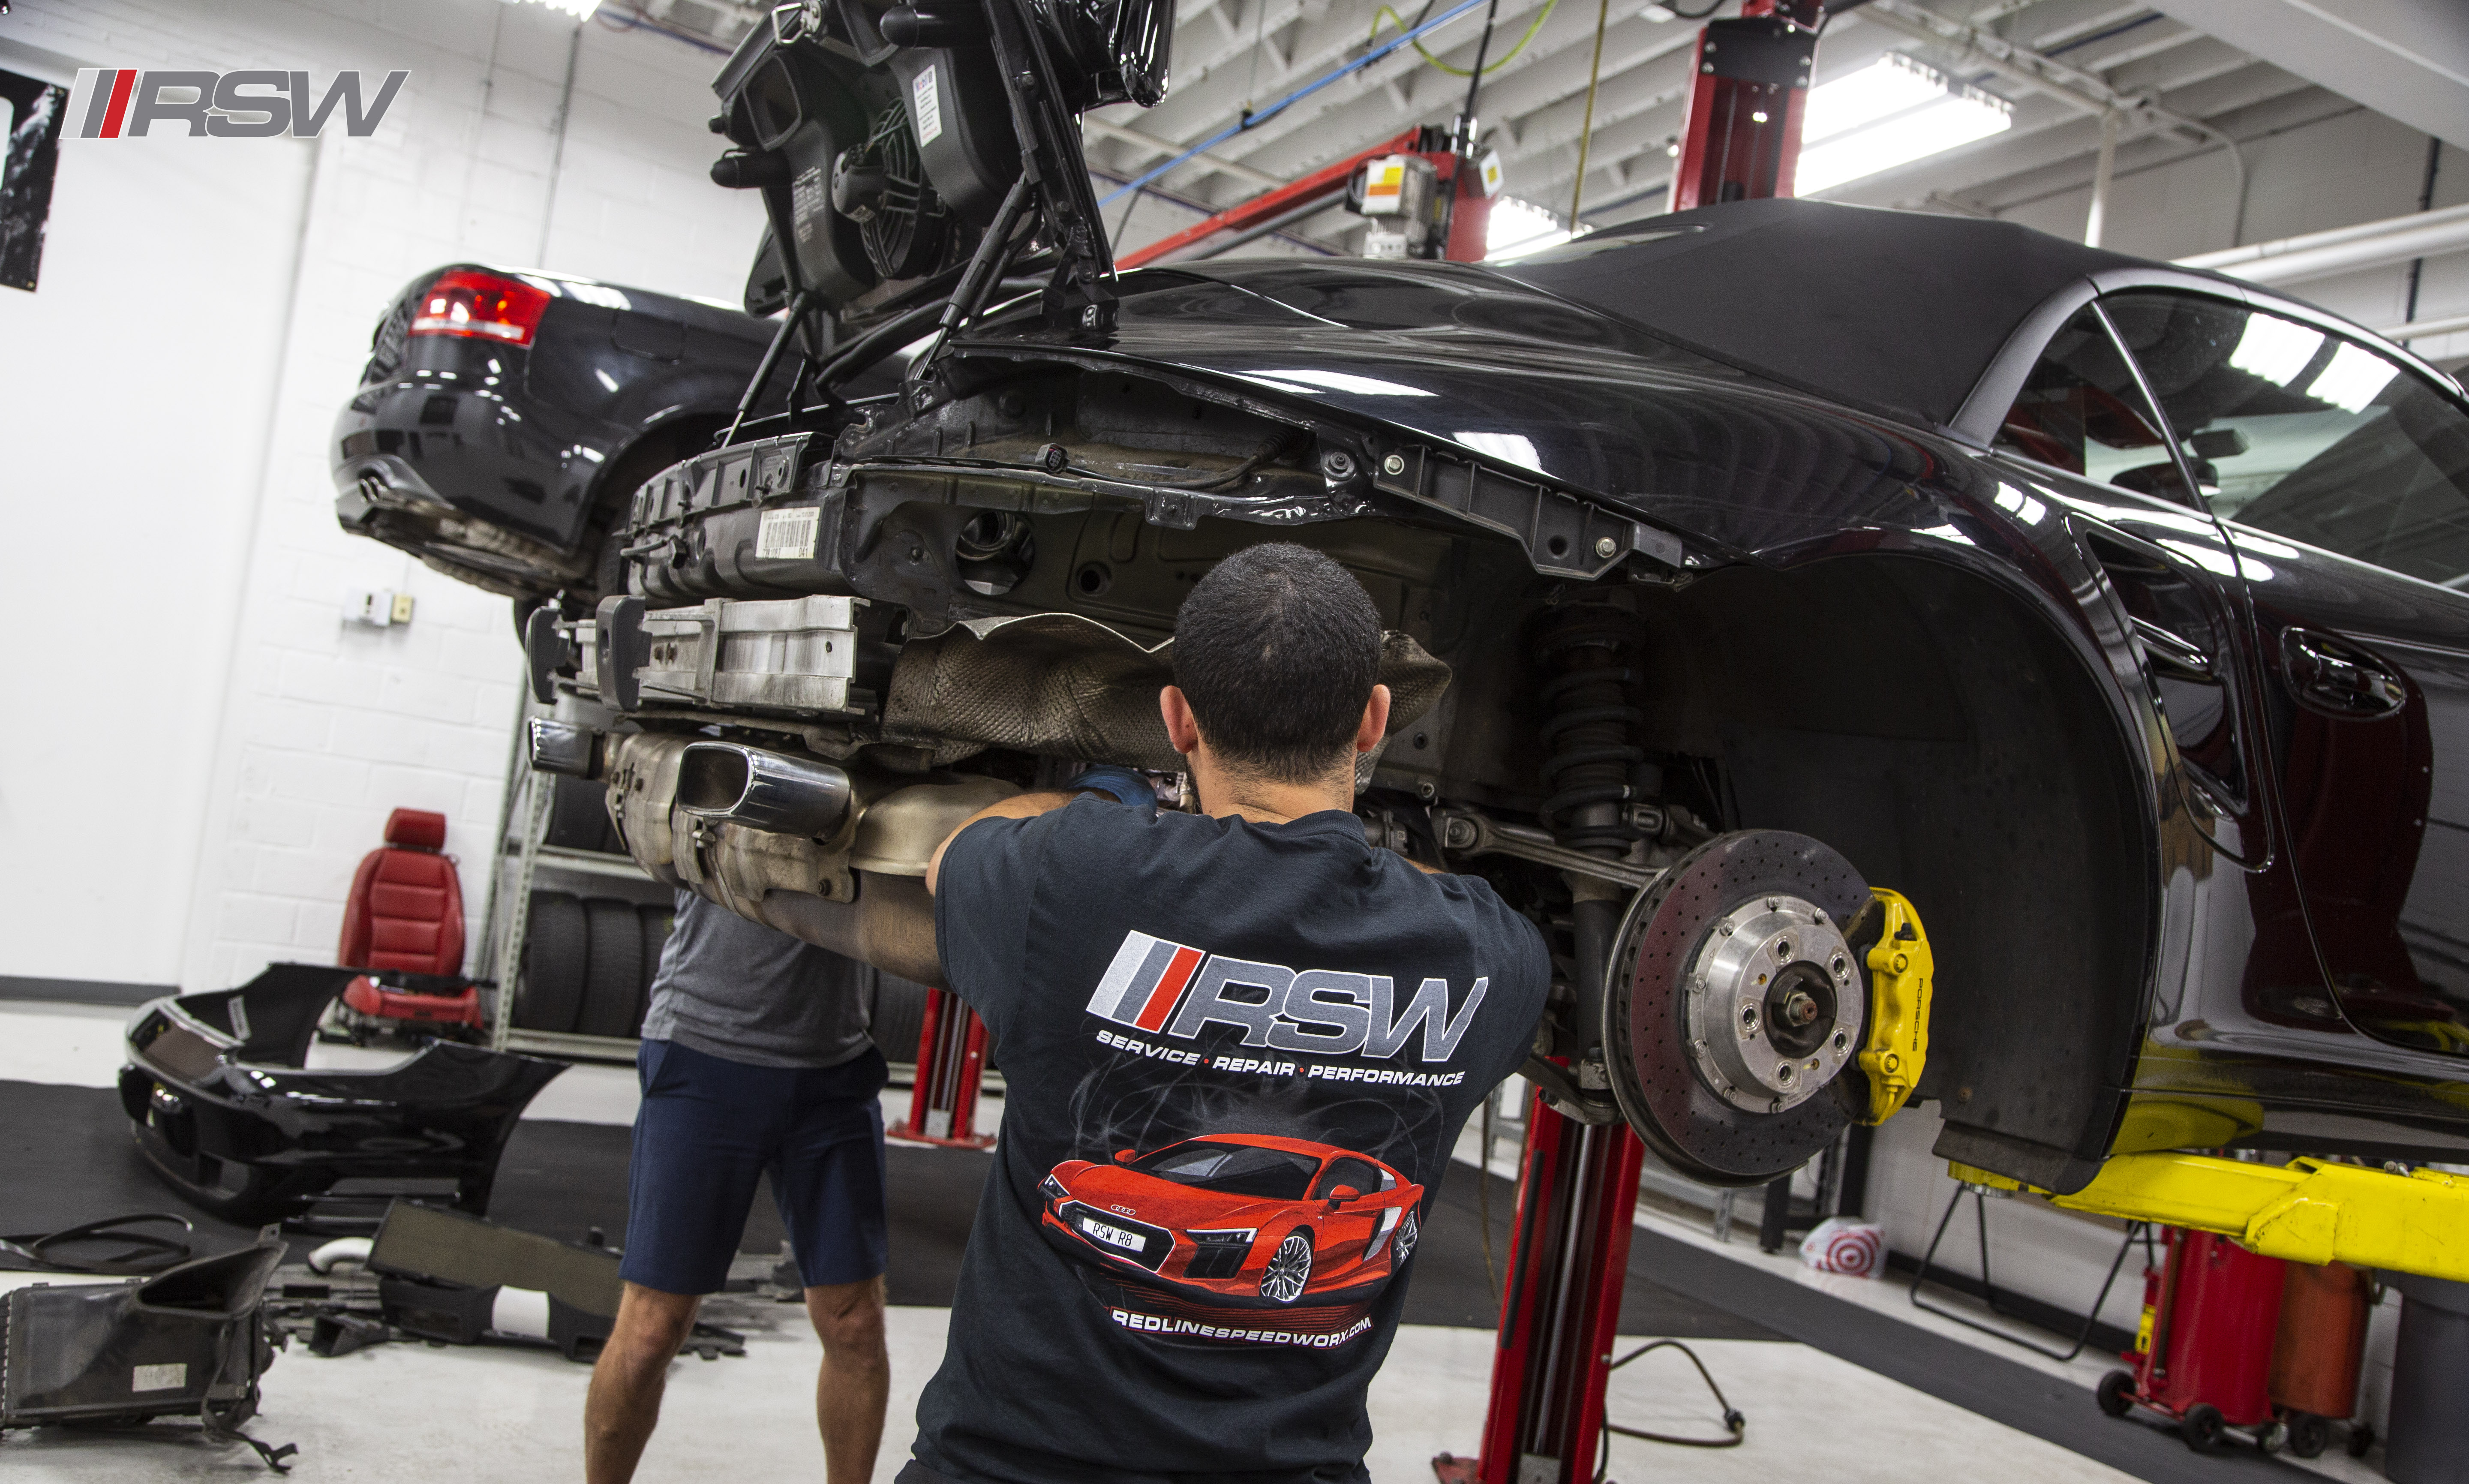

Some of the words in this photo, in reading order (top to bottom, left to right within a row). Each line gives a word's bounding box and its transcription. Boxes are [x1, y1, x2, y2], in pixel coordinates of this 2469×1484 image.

[799, 547, 808, 557] 041
[1168, 954, 1489, 1062] RSW
[1912, 978, 1923, 1051] PORSCHE
[1096, 1030, 1201, 1066] SERVICE
[1212, 1057, 1296, 1077] REPAIR
[1307, 1065, 1465, 1087] PERFORMANCE
[1093, 1223, 1114, 1241] RSW
[1117, 1231, 1133, 1247] R8
[1112, 1309, 1372, 1347] REDLINESPEEDWORX.COM
